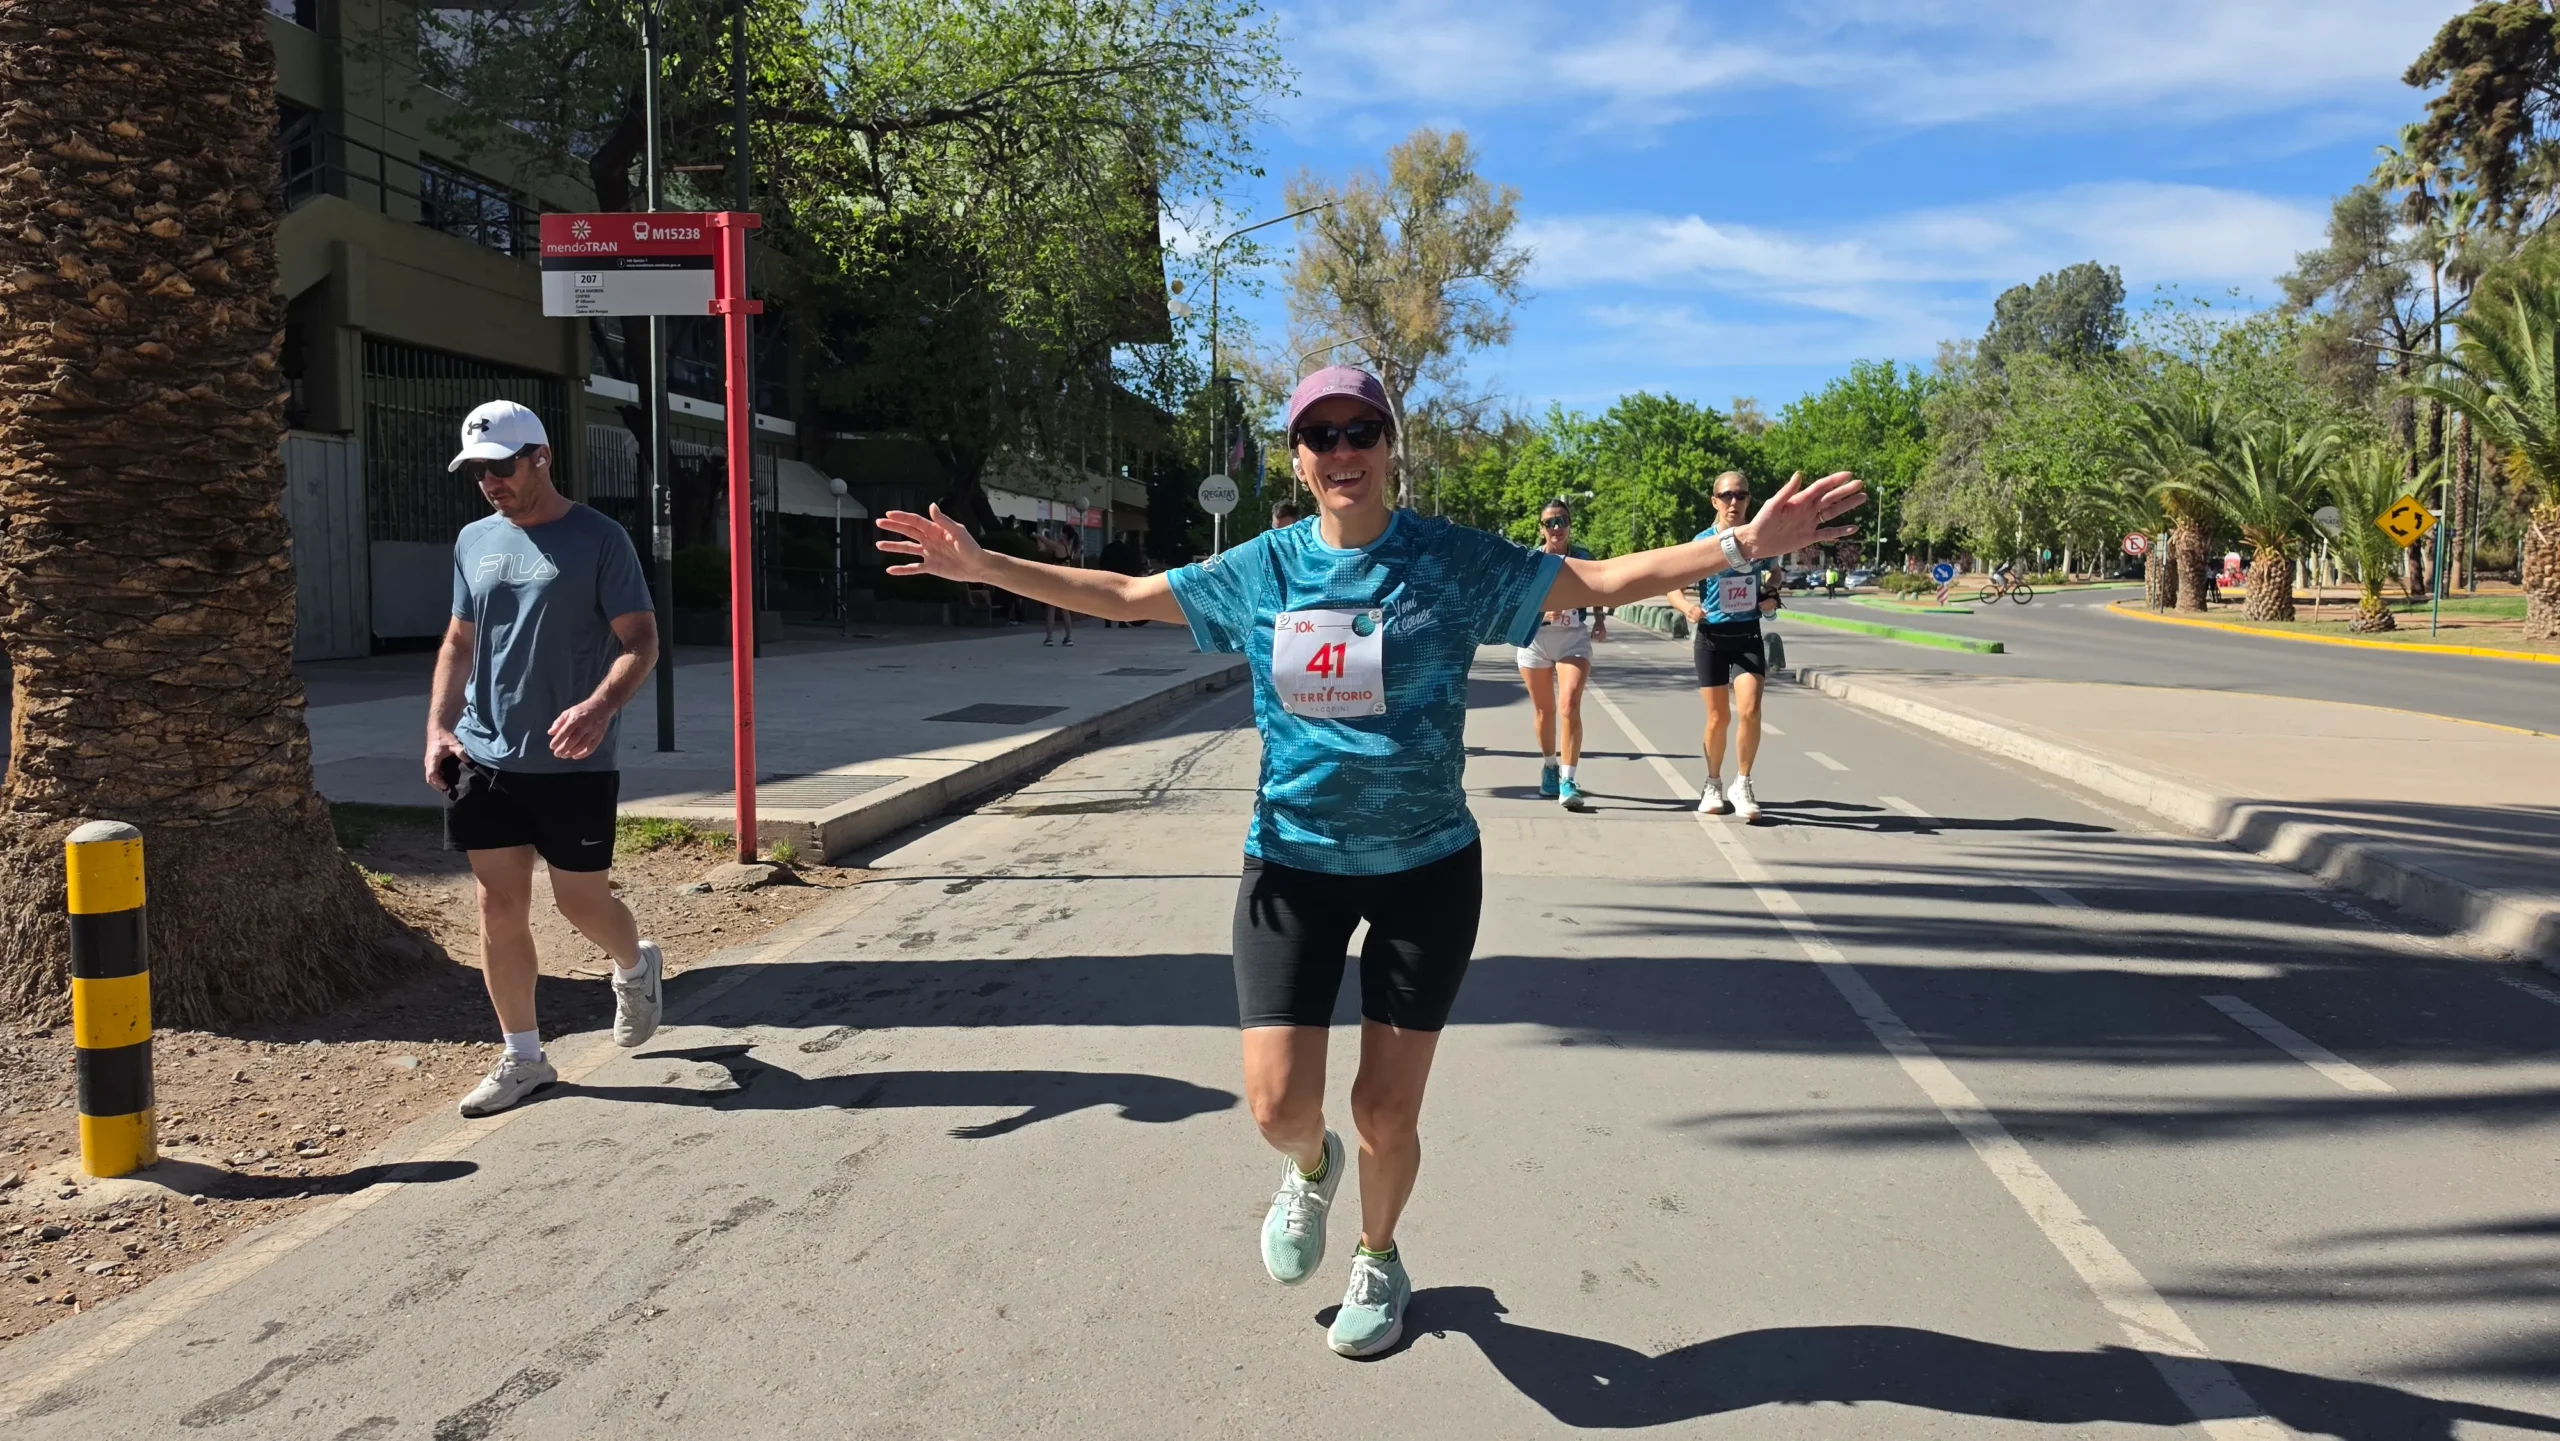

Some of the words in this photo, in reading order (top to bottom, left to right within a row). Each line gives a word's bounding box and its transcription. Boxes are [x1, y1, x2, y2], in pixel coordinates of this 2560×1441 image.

[652, 228, 700, 240] M15238
[547, 242, 618, 253] mendoTRAN
[580, 275, 597, 284] 207
[1201, 489, 1235, 501] REGATAS
[475, 553, 559, 582] FILA
[1728, 587, 1747, 600] 174
[1294, 621, 1315, 633] 10k
[1392, 621, 1401, 635] a
[1306, 642, 1346, 679] 41
